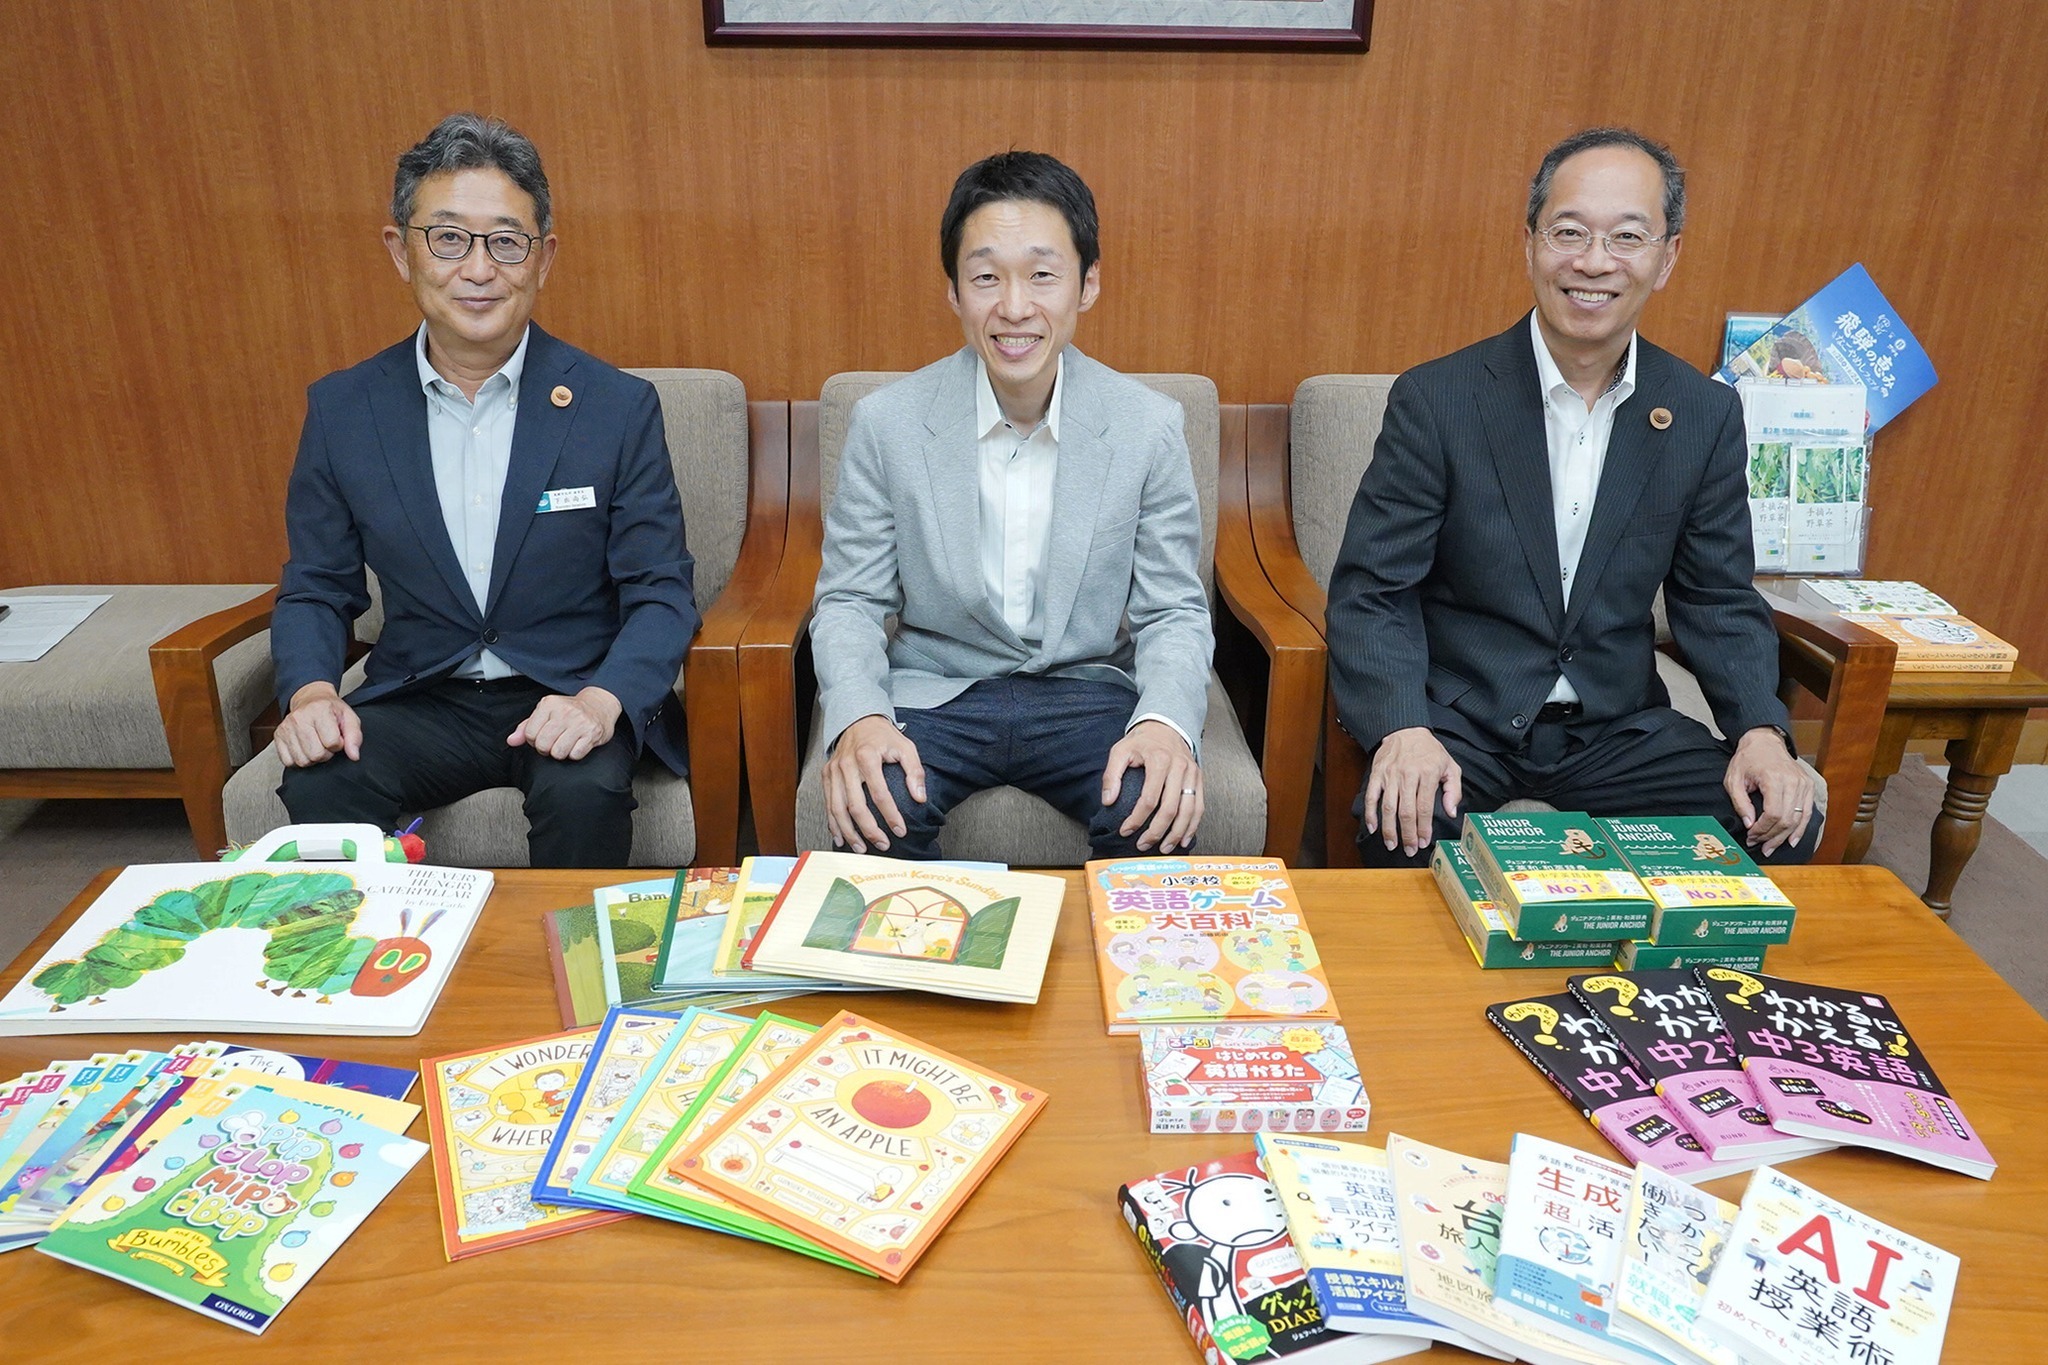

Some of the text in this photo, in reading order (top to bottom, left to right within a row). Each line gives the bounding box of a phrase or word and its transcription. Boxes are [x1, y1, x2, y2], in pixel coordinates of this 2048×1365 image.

[1834, 310, 1896, 390] 飛騨の恵み
[1481, 818, 1533, 828] JUNIOR
[1486, 827, 1546, 838] ANCHOR
[1610, 823, 1663, 833] JUNIOR
[1617, 832, 1677, 842] ANCHOR
[367, 886, 472, 899] CATERPILLAR
[849, 872, 886, 885] Bam
[886, 871, 908, 879] and
[955, 875, 1007, 902] Sunday
[1162, 876, 1222, 887] 小学校
[1547, 884, 1593, 895] No.1
[628, 892, 667, 903] Bam
[1111, 890, 1284, 911] 英語ゲーム
[1686, 889, 1734, 900] No.1
[1155, 912, 1254, 932] 大百科
[1583, 921, 1646, 930] THE JUNIOR ANCHOR
[1724, 926, 1787, 935] THE JUNIOR ANCHOR
[1550, 948, 1611, 957] THE JUNIOR ANCHOR
[1732, 962, 1759, 970] ANCHOR
[1559, 1013, 1605, 1038] わ
[1767, 1010, 1882, 1050] かえる
[249, 1054, 274, 1068] The
[489, 1043, 594, 1077] I WONDER
[1215, 1051, 1287, 1062] はじめての
[1580, 1038, 1620, 1065] か
[1747, 1027, 1919, 1086] 中3英語
[864, 1049, 983, 1106] IT MIGHT BE
[1203, 1063, 1306, 1079] 英語かるた
[1577, 1065, 1651, 1099] 中1
[810, 1107, 912, 1158] AN APPLE
[1720, 1132, 1748, 1140] BUNRI
[1662, 1160, 1688, 1170] BUNRI
[1341, 1180, 1395, 1203] 英語
[1537, 1166, 1623, 1214] 生成
[190, 1195, 266, 1239] Bop
[1453, 1199, 1502, 1240] 台
[129, 1230, 220, 1271] Bumbles
[1776, 1213, 1904, 1310] AI
[1782, 1264, 1877, 1334] 英語
[213, 1299, 256, 1322] OXFORD
[1268, 1307, 1321, 1334] DIAR
[1748, 1276, 1896, 1365] 授業術
